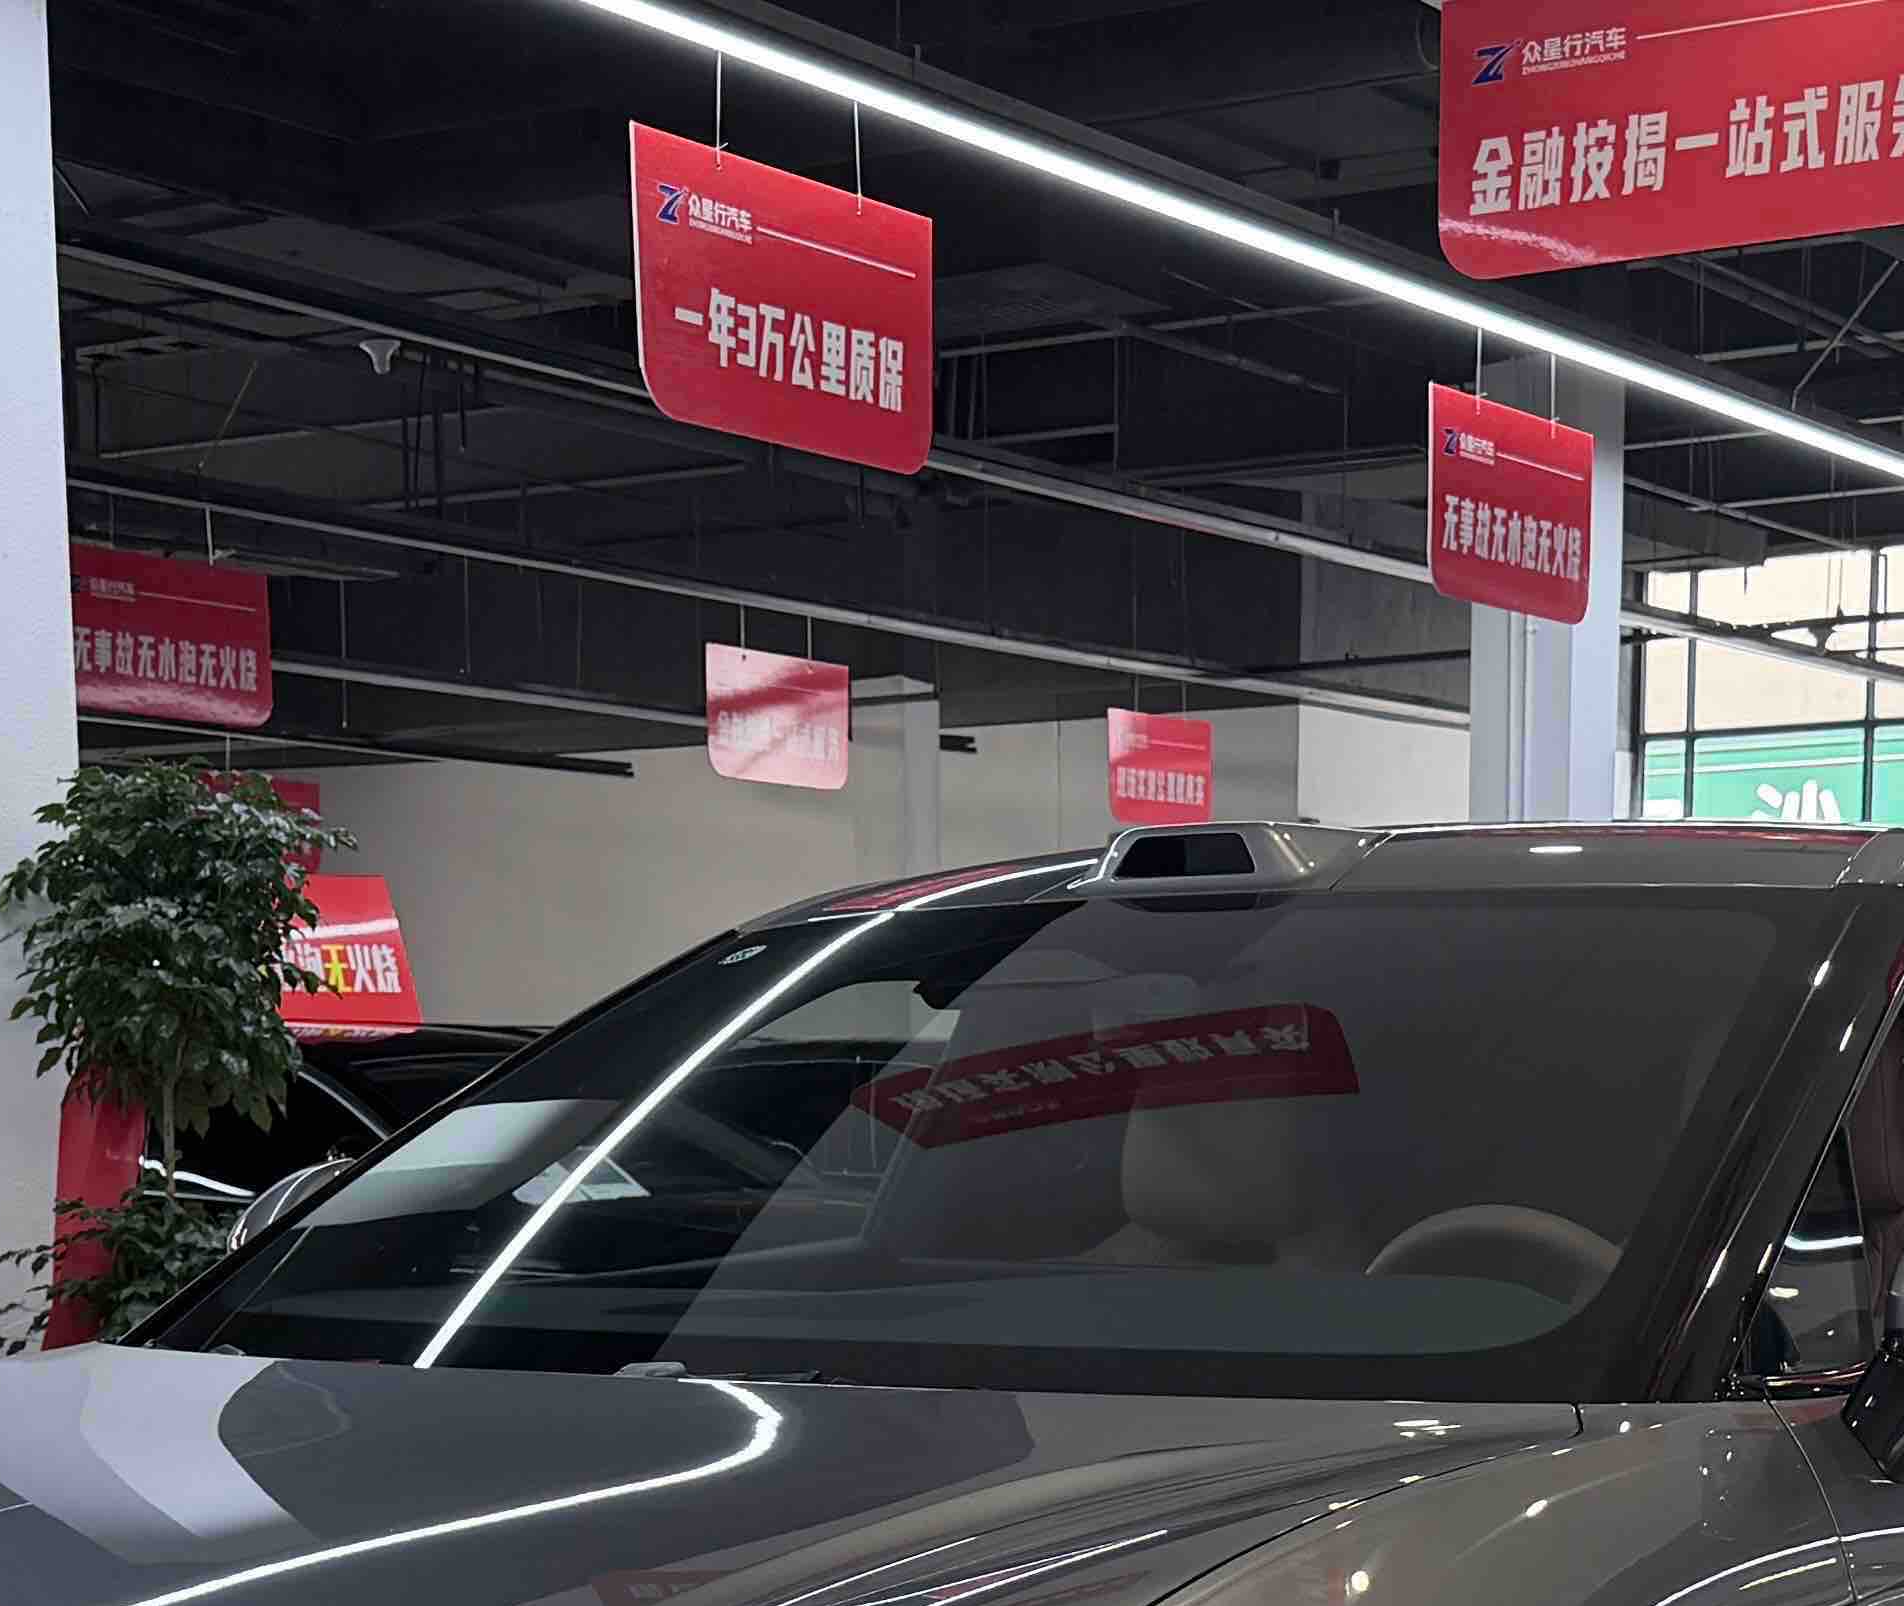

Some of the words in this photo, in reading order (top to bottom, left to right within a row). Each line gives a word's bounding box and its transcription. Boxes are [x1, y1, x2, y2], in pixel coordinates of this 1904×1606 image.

[1520, 27, 1627, 66] 众星行汽车
[688, 193, 753, 232] 众星行汽车
[674, 288, 905, 412] 一年3万公里质保
[1442, 494, 1581, 581] 无事故无水泡无火烧
[74, 625, 257, 692] 无事故无水泡无火烧
[282, 943, 402, 993] 泡无火烧
